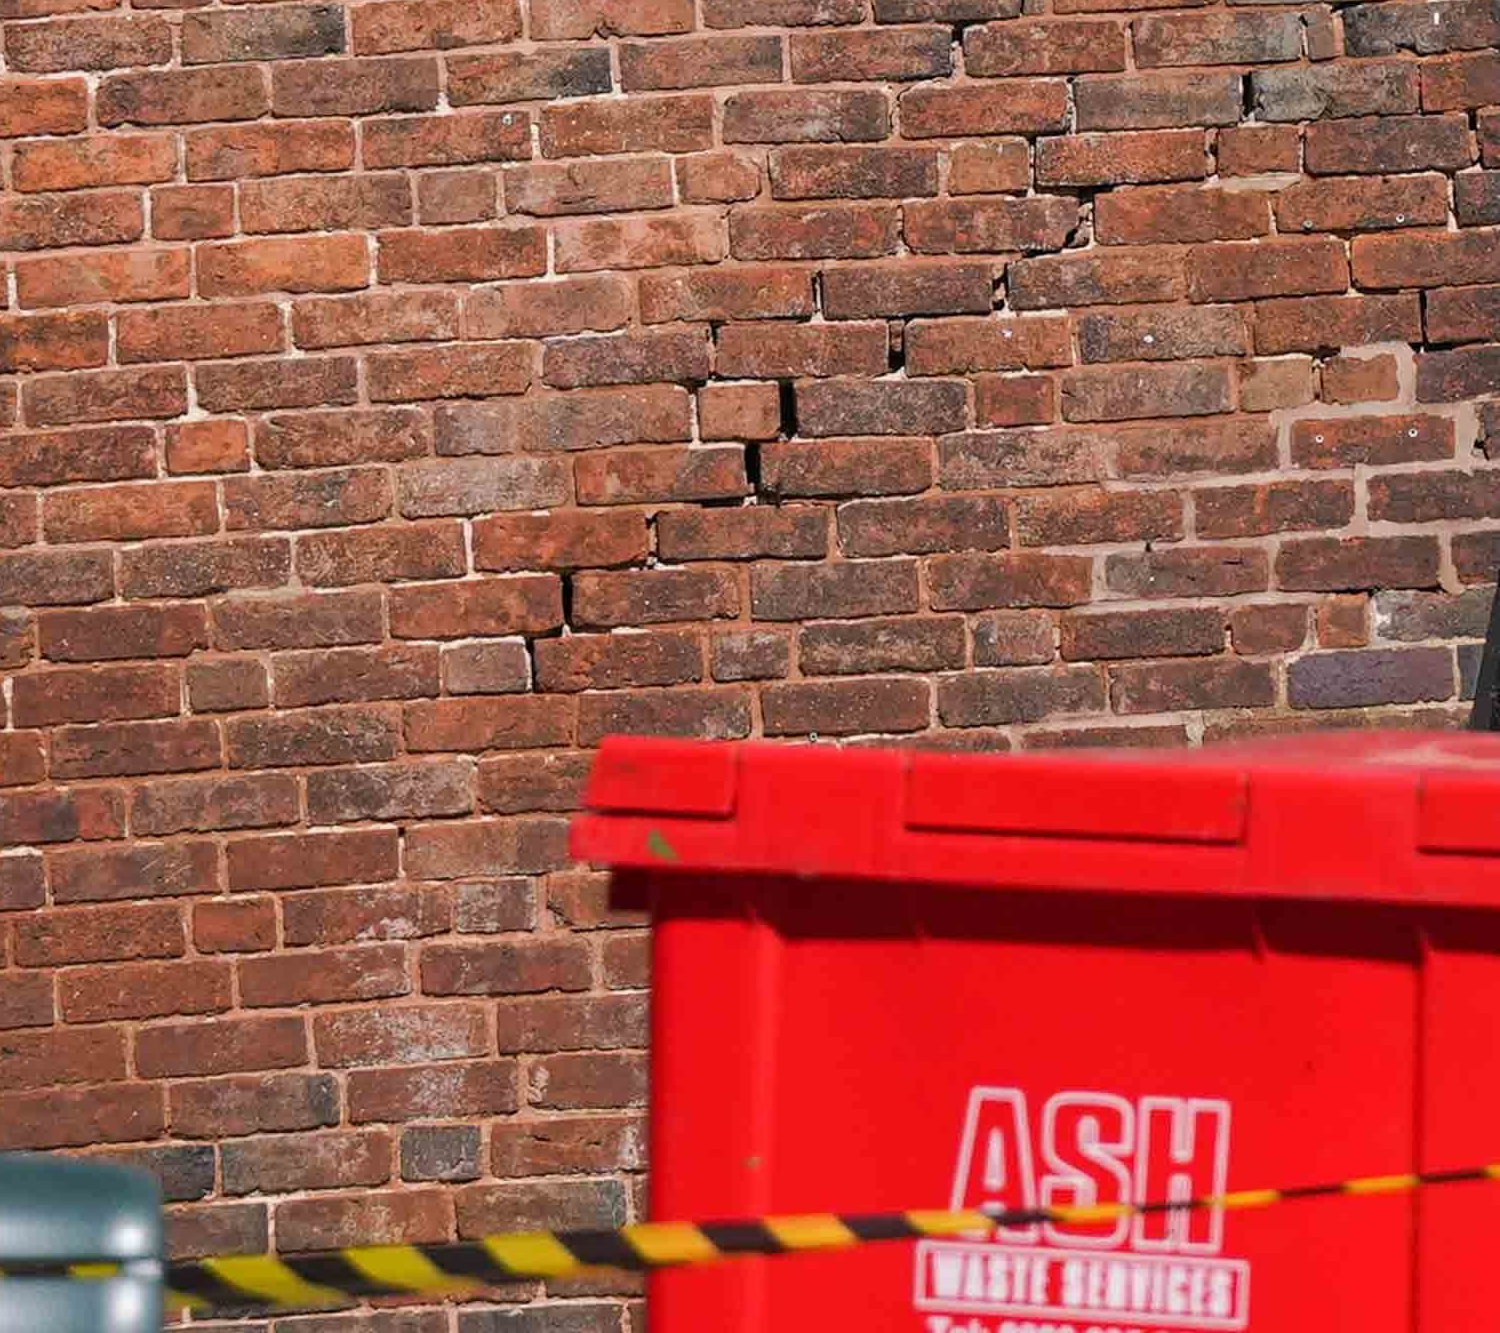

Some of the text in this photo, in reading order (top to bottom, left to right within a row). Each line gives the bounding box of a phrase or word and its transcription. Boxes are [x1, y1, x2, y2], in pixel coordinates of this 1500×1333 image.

[950, 1085, 1231, 1254] ASH
[933, 1249, 1233, 1317] WASTE SERVICES
